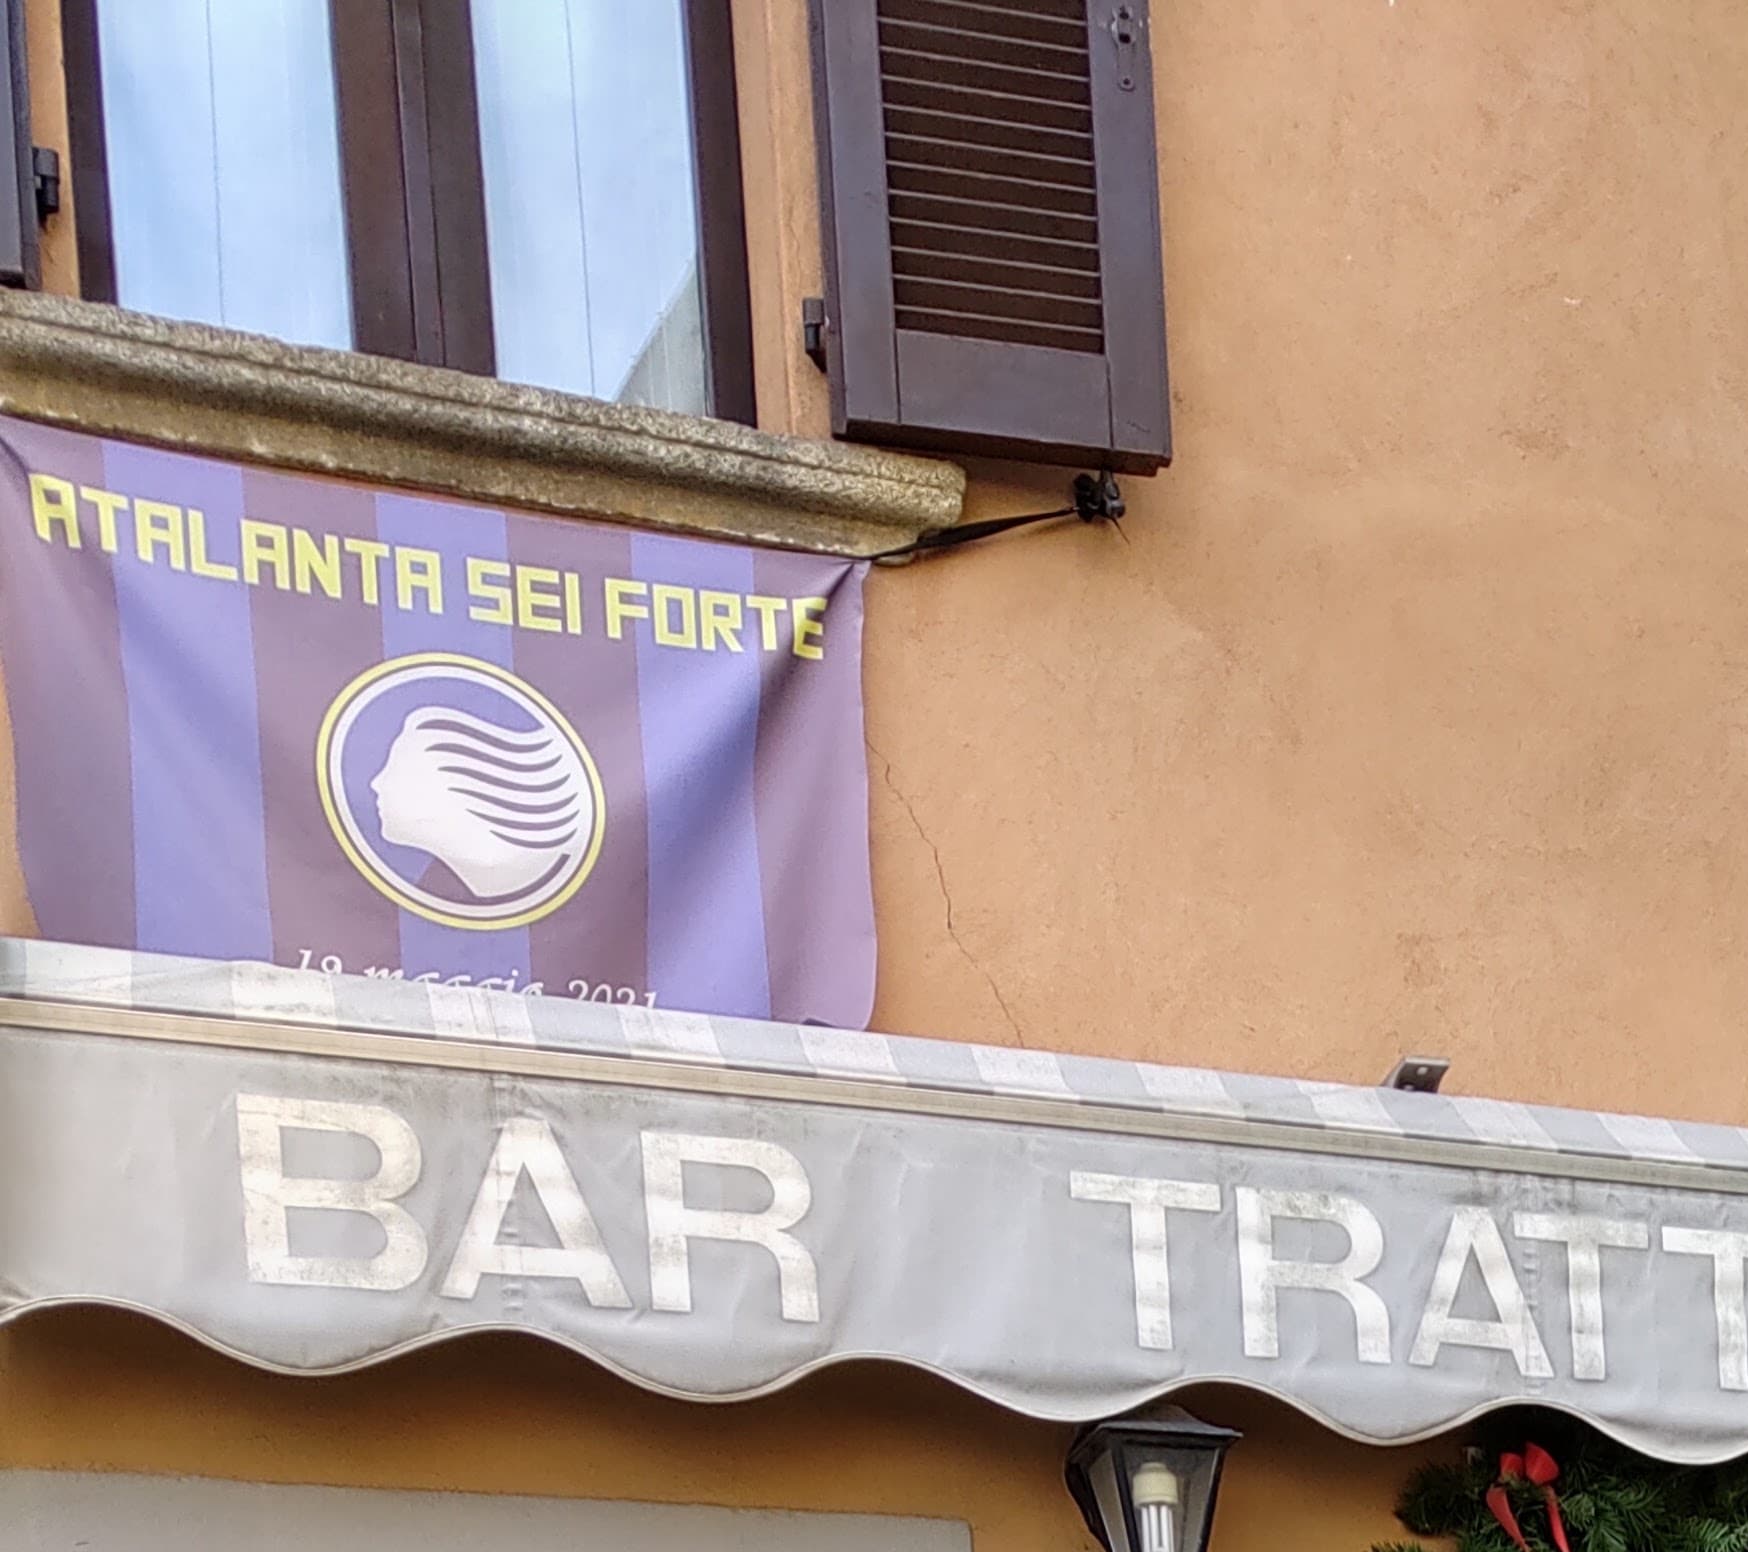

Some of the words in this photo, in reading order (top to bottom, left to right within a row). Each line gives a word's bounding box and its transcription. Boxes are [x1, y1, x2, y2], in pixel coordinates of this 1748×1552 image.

[28, 472, 444, 615] ATALANTA
[466, 556, 583, 636] SEI
[603, 577, 827, 662] FORTE
[234, 1092, 820, 1323] BAR
